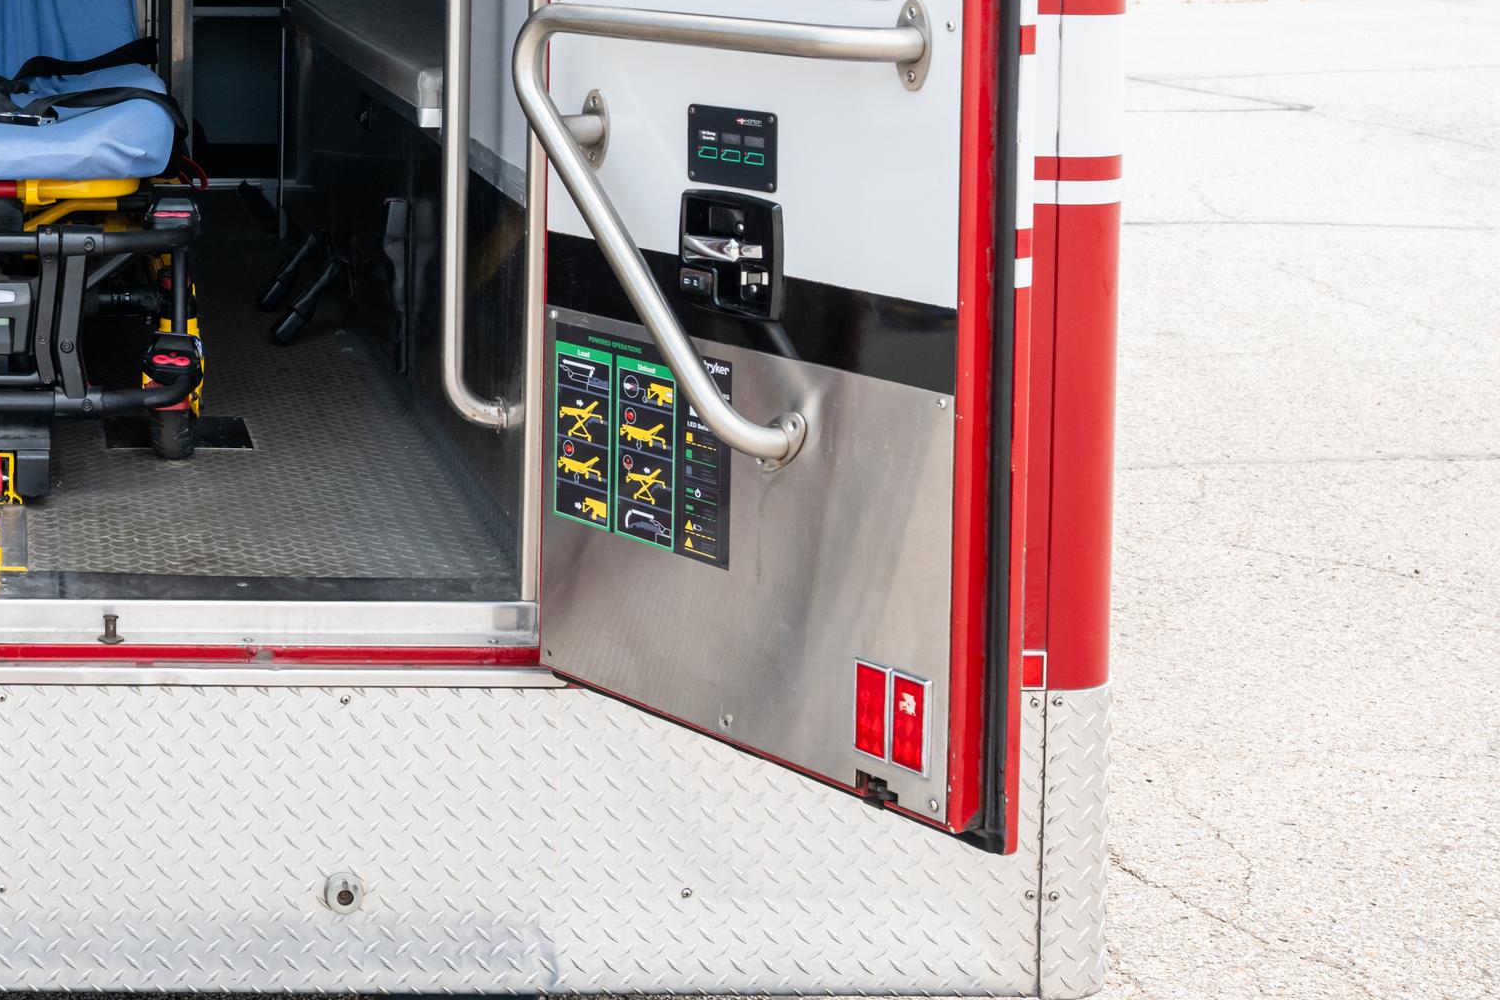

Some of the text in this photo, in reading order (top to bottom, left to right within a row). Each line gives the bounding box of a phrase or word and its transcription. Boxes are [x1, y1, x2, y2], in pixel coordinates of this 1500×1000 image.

[588, 335, 642, 354] POWERED OPERATIONS
[577, 349, 590, 358] Load
[637, 363, 656, 374] Unload
[704, 360, 730, 375] ryker
